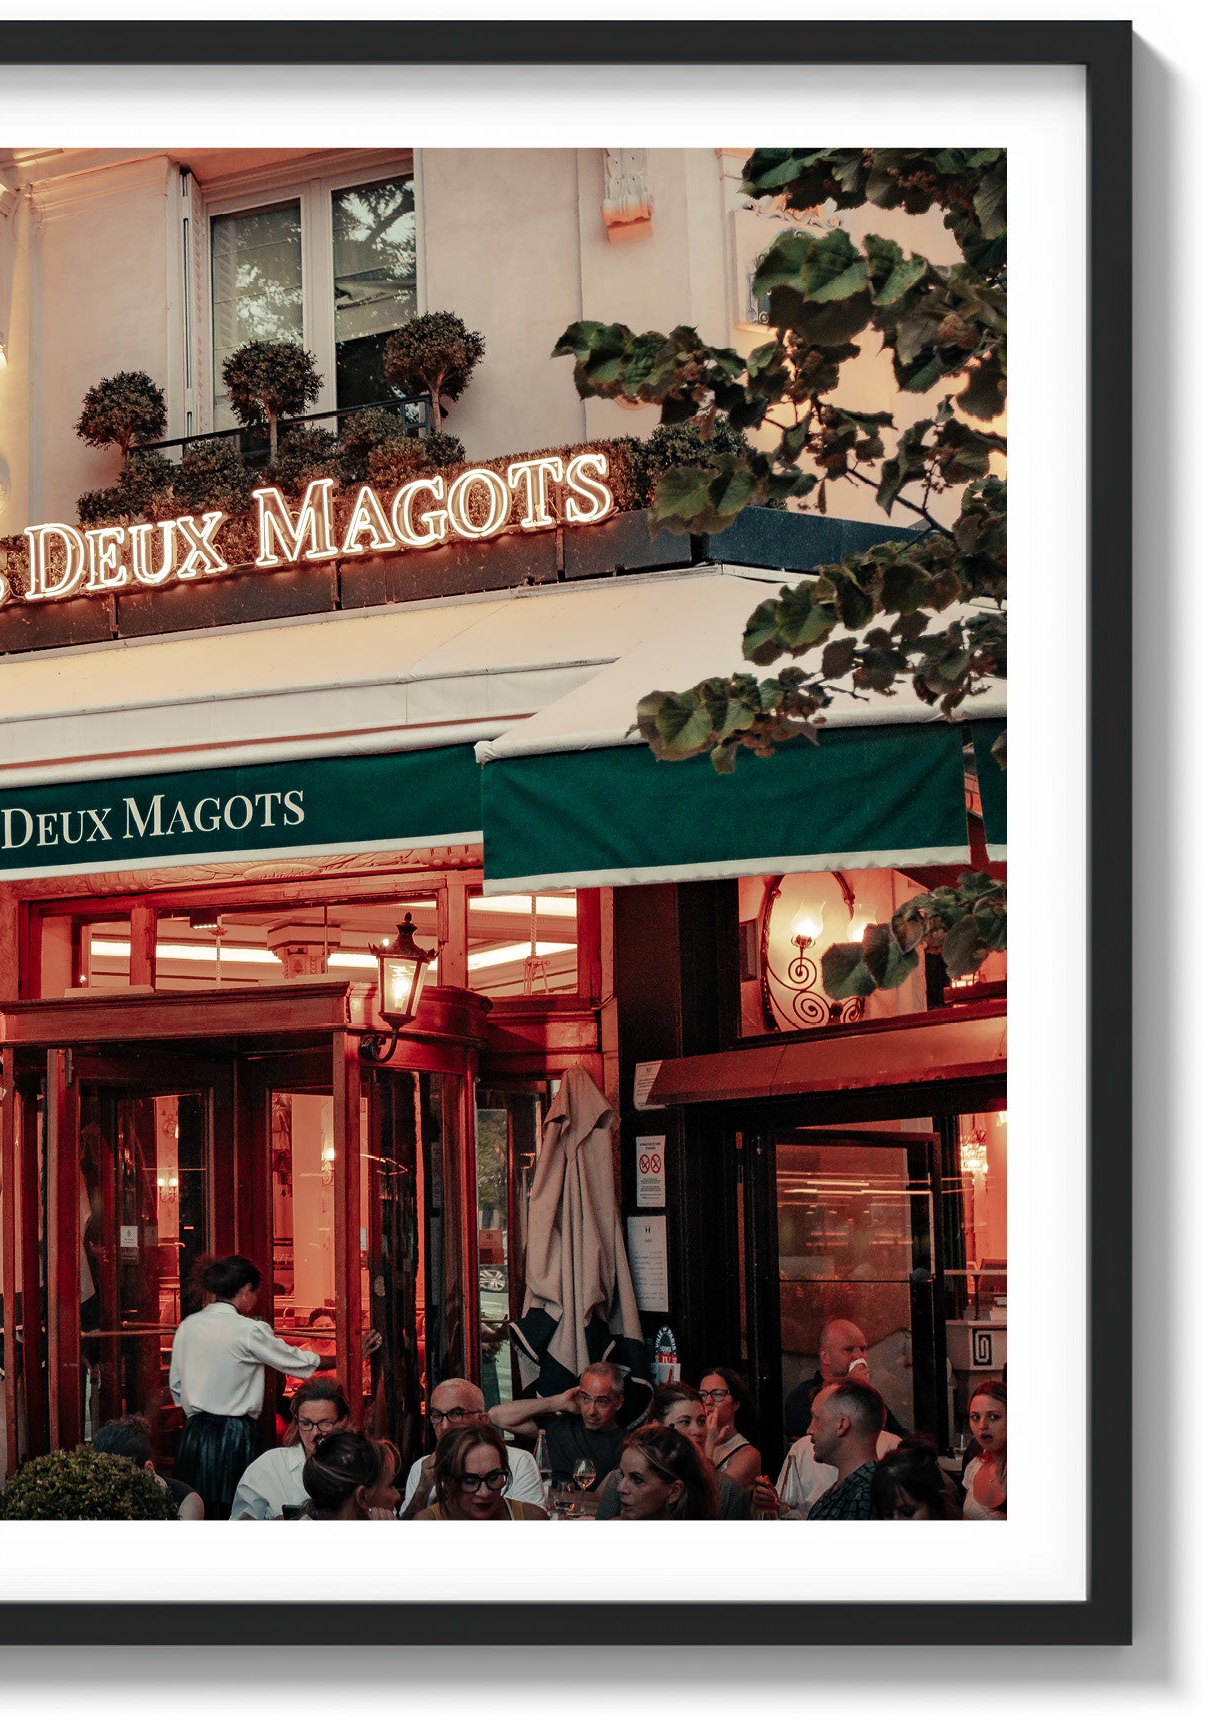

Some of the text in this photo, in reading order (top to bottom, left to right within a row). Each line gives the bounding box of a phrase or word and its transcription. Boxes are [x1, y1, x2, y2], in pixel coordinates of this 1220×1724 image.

[23, 511, 228, 600] DEUX
[252, 454, 613, 567] MAGOTS
[1, 807, 112, 850] DEUX
[123, 790, 305, 840] MAGOTS
